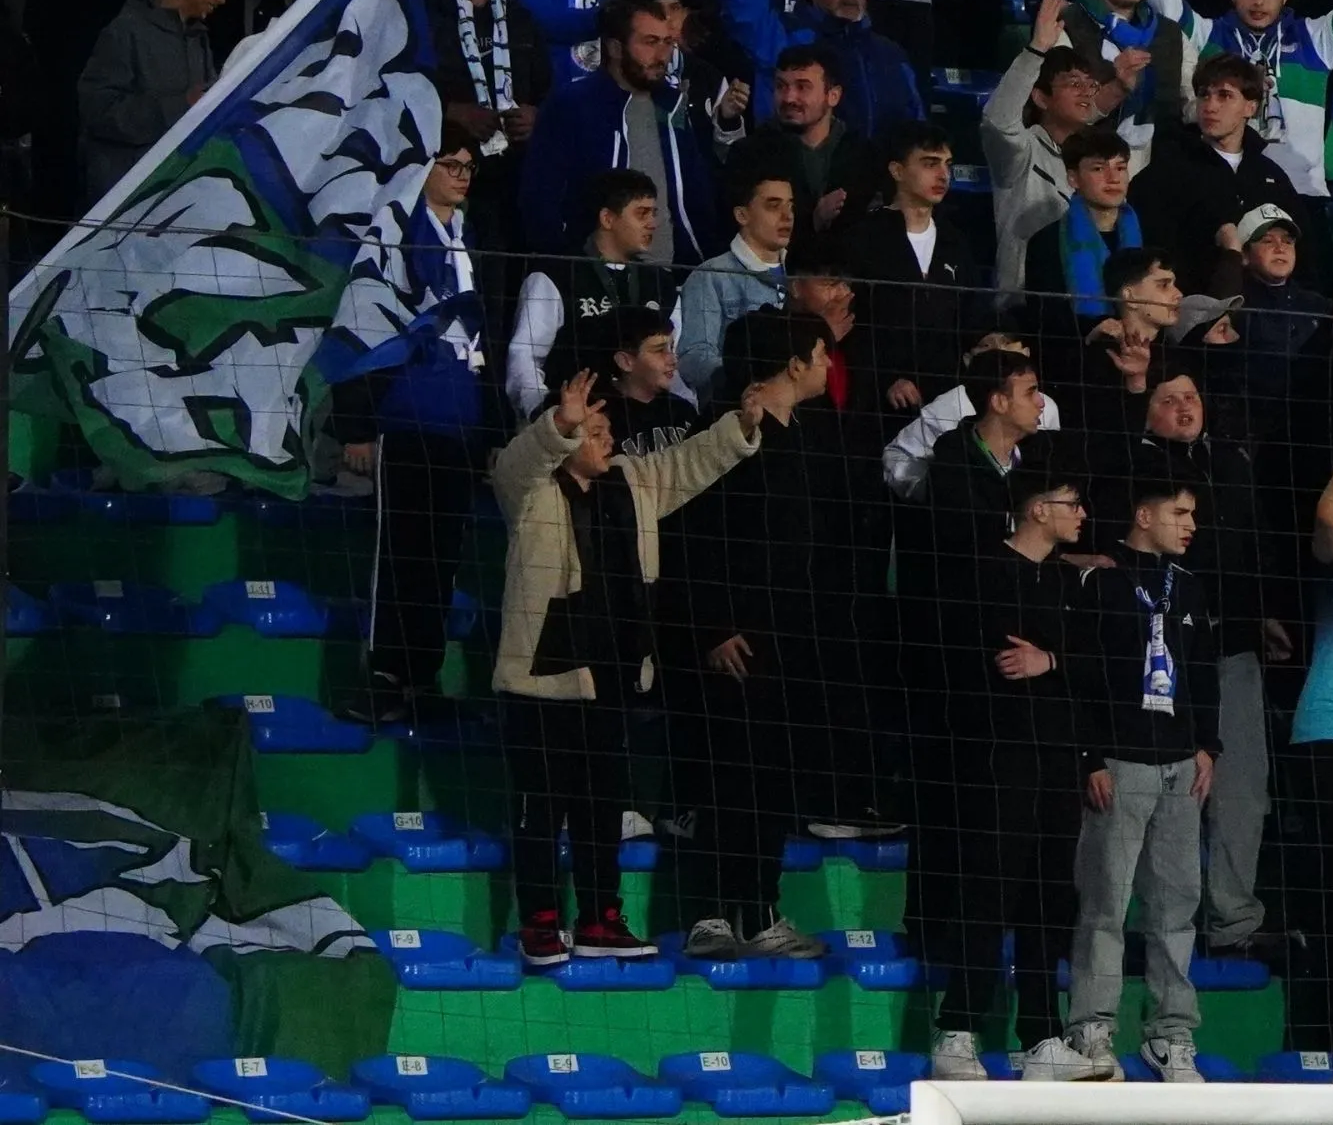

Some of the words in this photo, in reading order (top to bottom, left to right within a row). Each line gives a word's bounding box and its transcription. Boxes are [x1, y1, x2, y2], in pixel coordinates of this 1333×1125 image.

[702, 1056, 729, 1068] E-10
[859, 1054, 885, 1067] E-11
[1302, 1055, 1328, 1067] E-14
